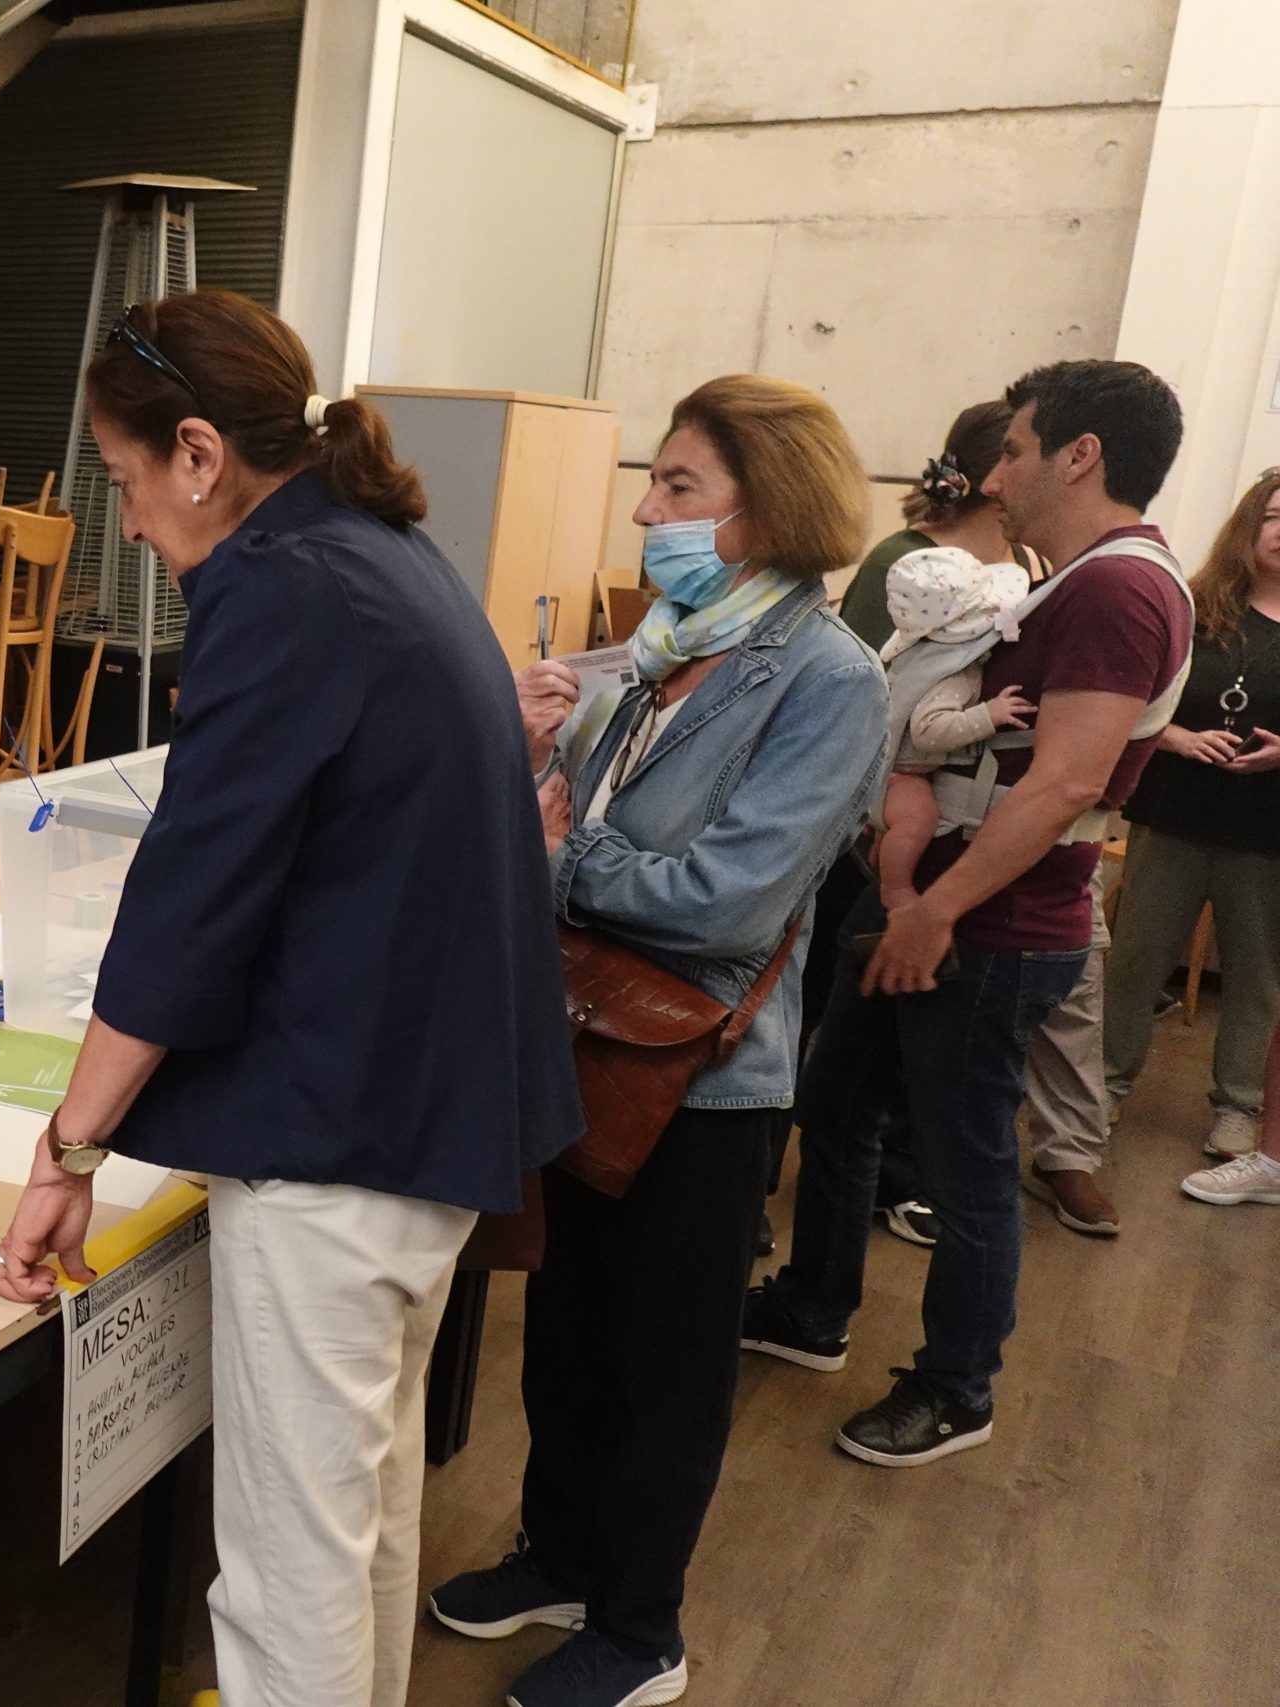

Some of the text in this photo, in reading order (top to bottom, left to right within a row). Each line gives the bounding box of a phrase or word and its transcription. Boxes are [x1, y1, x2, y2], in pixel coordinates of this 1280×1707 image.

[82, 1297, 151, 1371] MESA:
[121, 1313, 175, 1367] VOCALES
[76, 1413, 81, 1431] 1
[75, 1439, 82, 1460] 2
[74, 1465, 81, 1484] 3
[73, 1491, 80, 1508] 4
[73, 1516, 80, 1536] 5
